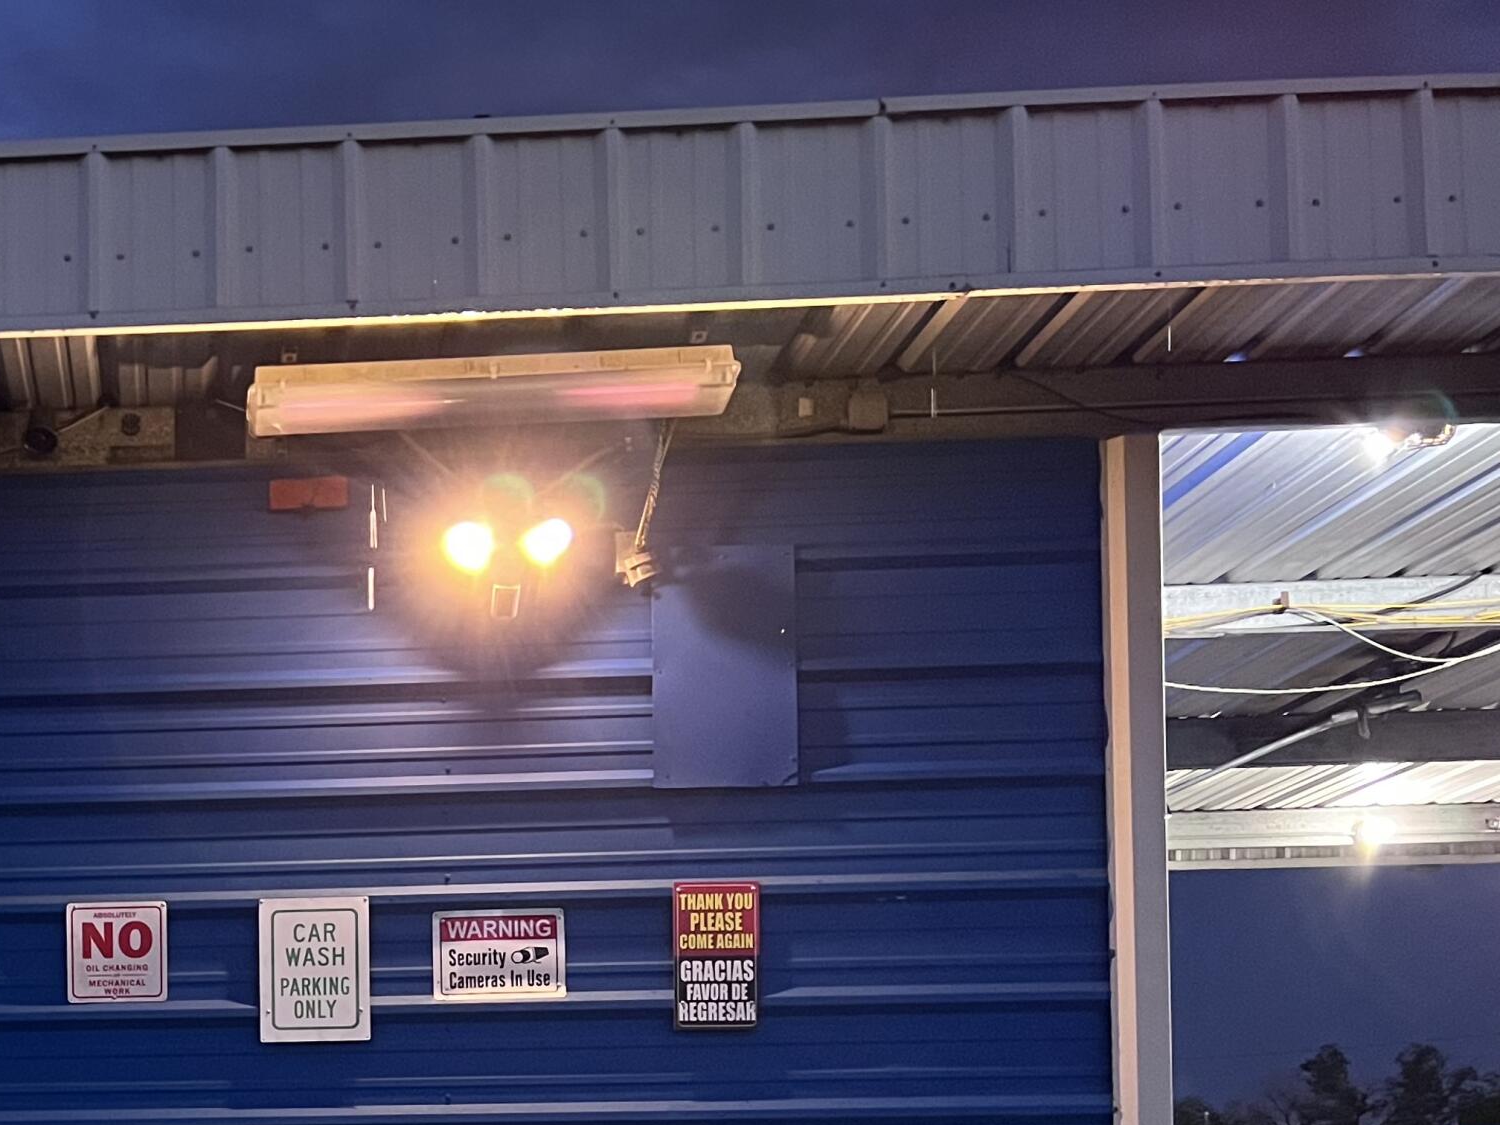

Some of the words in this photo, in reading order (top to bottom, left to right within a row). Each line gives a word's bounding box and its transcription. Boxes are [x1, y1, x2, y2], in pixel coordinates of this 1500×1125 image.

[680, 893, 723, 911] THANK
[726, 893, 753, 910] YOU
[447, 919, 551, 939] WARNING
[690, 912, 743, 931] PLEASE
[82, 921, 153, 959] NO
[293, 923, 336, 942] CAR
[679, 934, 714, 949] COME
[716, 933, 754, 949] AGAIN
[285, 947, 345, 967] WASH
[448, 948, 506, 969] Security
[102, 964, 148, 972] CHANGING
[680, 960, 754, 982] GRACIAS
[89, 979, 146, 987] MECHANICAL
[280, 977, 350, 996] PARKING
[449, 972, 506, 990] Cameras
[510, 970, 523, 987] In
[527, 969, 551, 987] Use
[686, 983, 728, 1001] FAVOR
[731, 983, 748, 1000] DE
[294, 1000, 337, 1019] ONLY
[679, 1001, 756, 1022] REGRESAR
